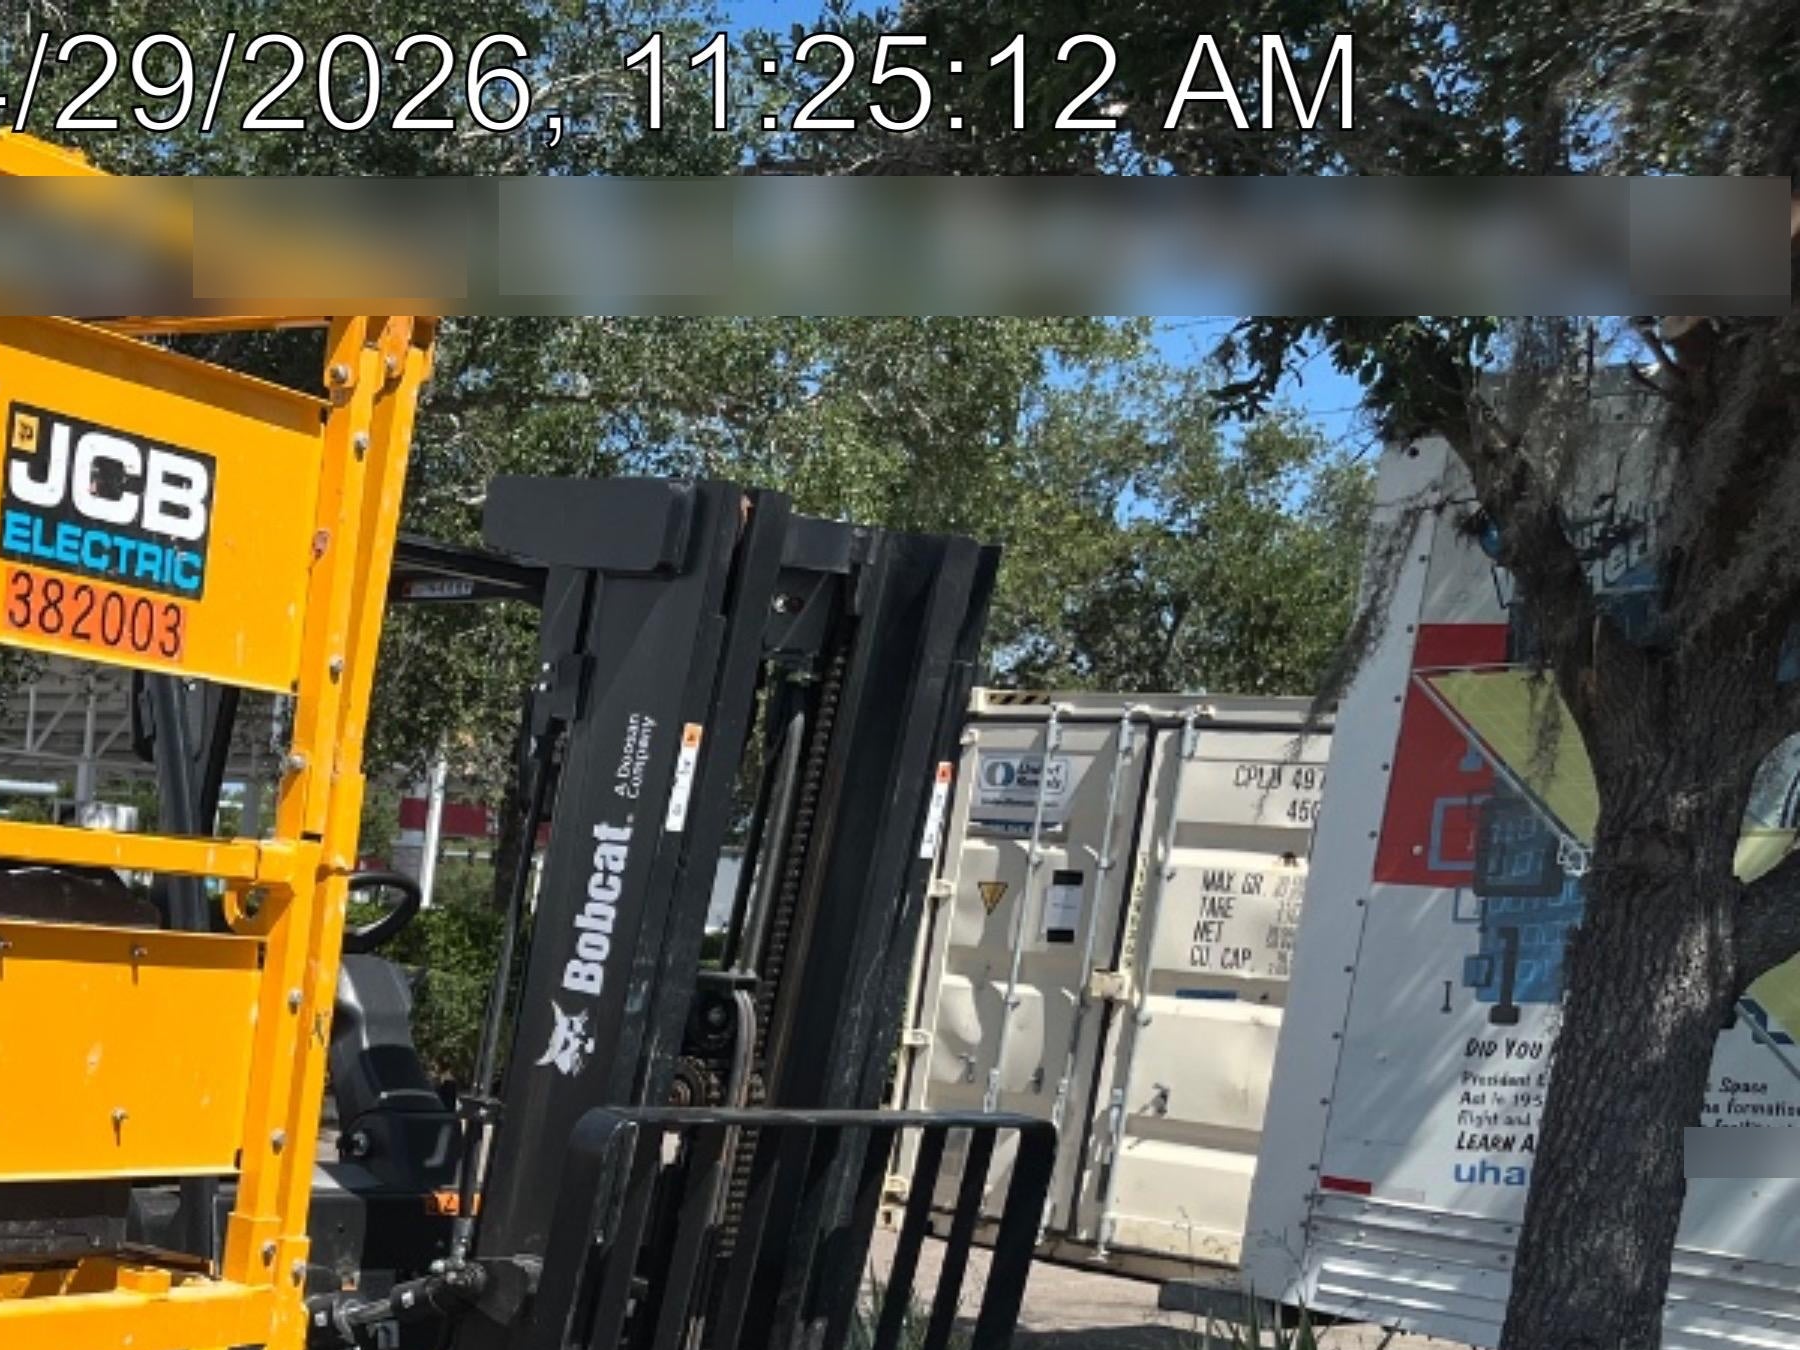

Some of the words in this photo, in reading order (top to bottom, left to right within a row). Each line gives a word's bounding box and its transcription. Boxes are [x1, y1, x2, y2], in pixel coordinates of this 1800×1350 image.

[8, 421, 208, 541] JCB
[2, 509, 201, 590] ELECTRIC
[8, 570, 182, 658] 382003
[562, 821, 634, 995] Bobcat
[1193, 920, 1224, 943] NET
[1464, 1037, 1498, 1058] DID
[1505, 1037, 1544, 1060] YOU
[1513, 1092, 1544, 1108] 195
[1456, 1130, 1517, 1152] LEARN
[1453, 1157, 1527, 1186] uha
